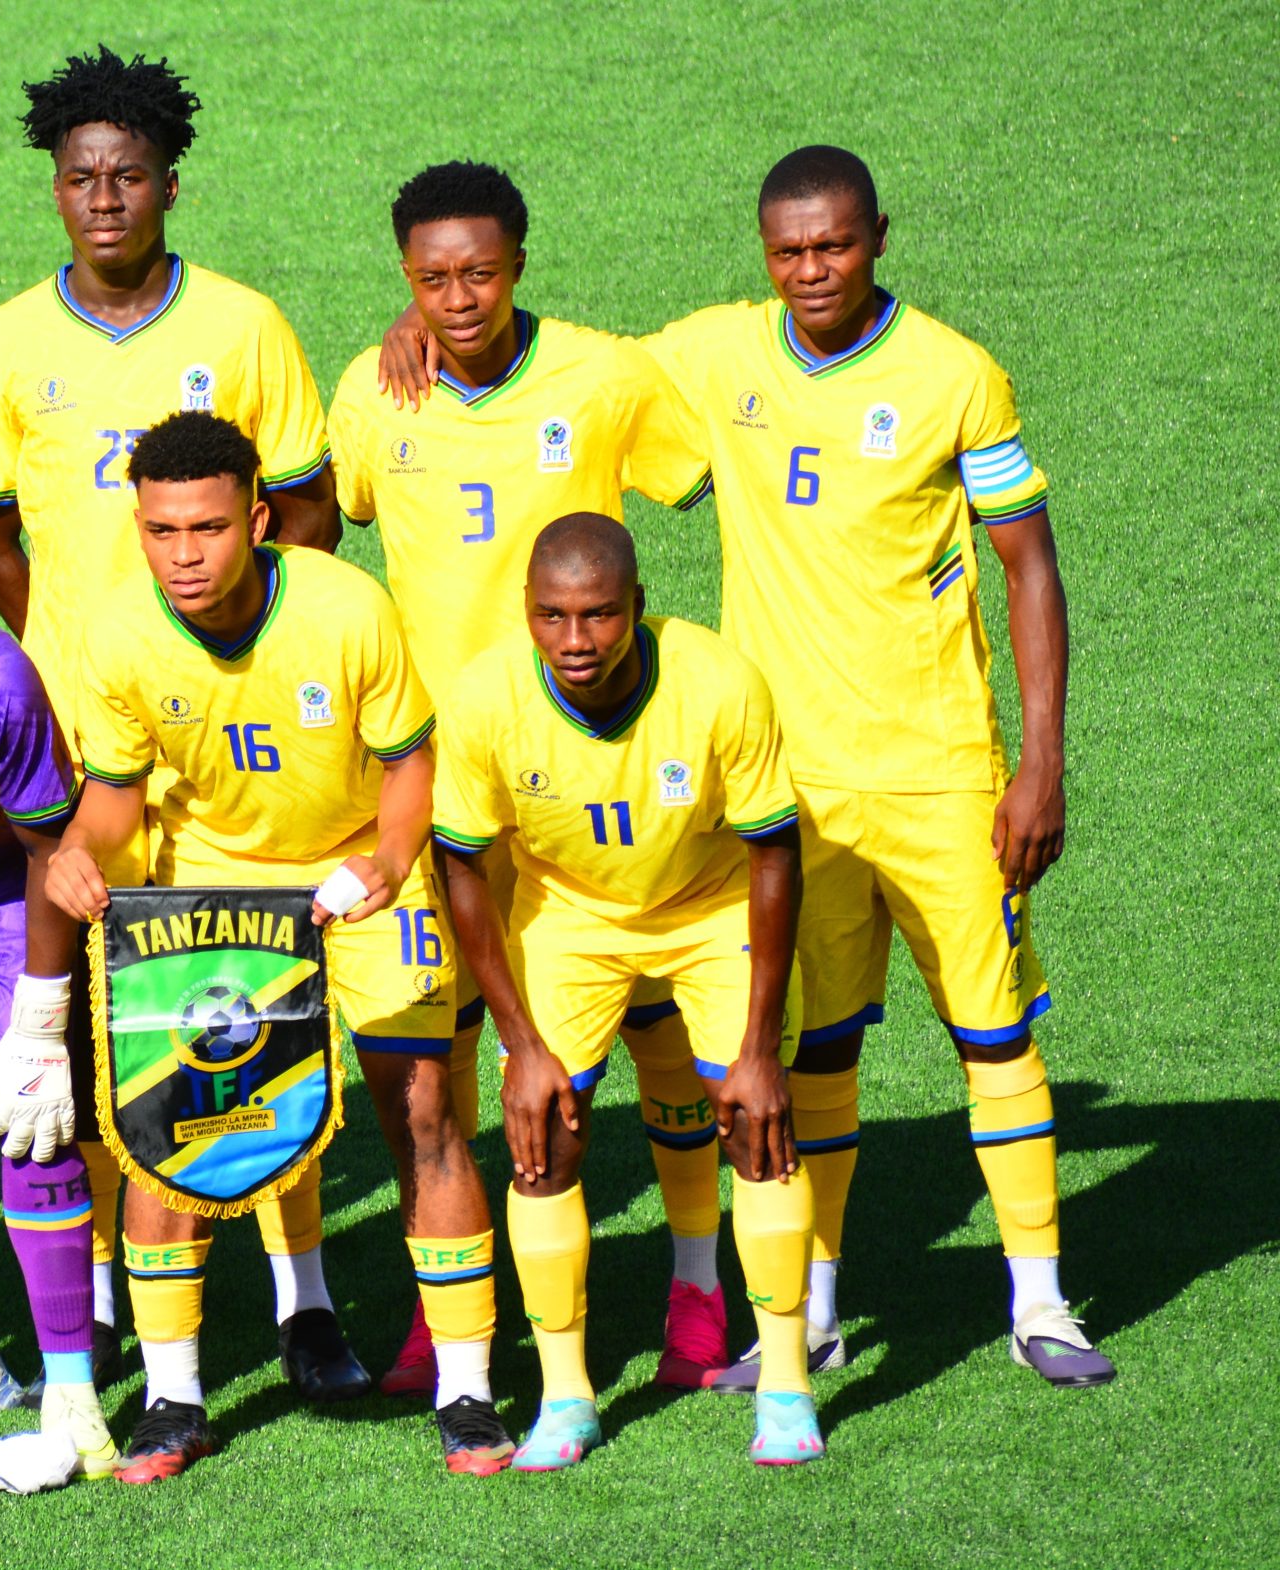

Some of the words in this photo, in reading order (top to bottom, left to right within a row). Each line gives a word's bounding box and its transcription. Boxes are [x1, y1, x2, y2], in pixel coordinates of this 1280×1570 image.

[785, 445, 821, 506] 6
[459, 482, 495, 543] 3
[222, 723, 281, 772] 16
[583, 801, 634, 846] 11
[126, 909, 294, 957] TANZANIA
[394, 908, 442, 967] 16
[180, 1118, 227, 1132] SHIRIKISHO
[229, 1116, 240, 1124] LA
[242, 1113, 269, 1122] MPIRA
[196, 1126, 224, 1136] MIGUU
[226, 1121, 268, 1132] TANZANIA
